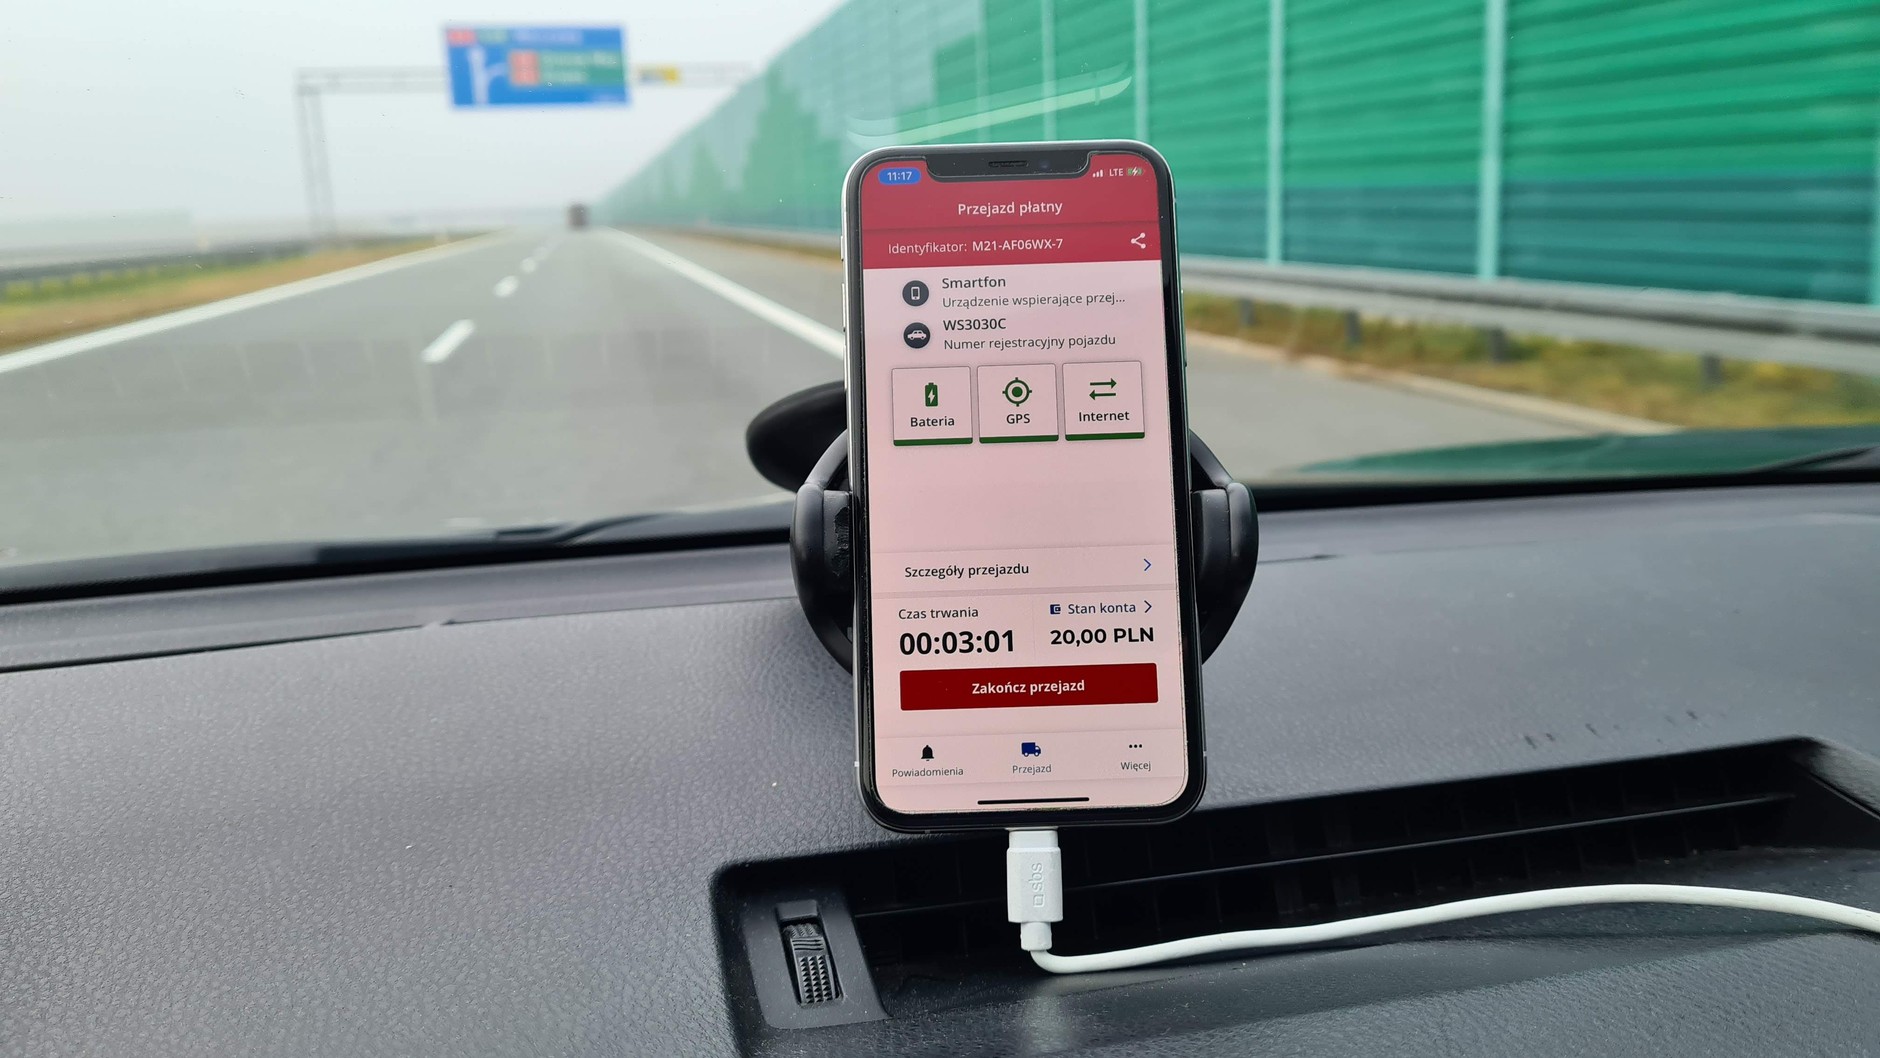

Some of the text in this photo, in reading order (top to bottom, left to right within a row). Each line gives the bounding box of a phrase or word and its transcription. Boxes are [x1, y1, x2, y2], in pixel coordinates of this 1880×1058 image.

[887, 170, 912, 182] 11:17
[1109, 168, 1124, 177] LTE
[957, 200, 1063, 218] Przejazd płatny
[888, 238, 1064, 257] Identyfikator: M21-AF06WX-7
[941, 276, 1006, 289] Smartfon
[942, 293, 1126, 310] Urządzenie wspierające przej...
[943, 318, 1006, 331] WS3030C
[944, 334, 1116, 352] Numer rejestracyjny pojazdu
[910, 415, 955, 428] Bateria
[1006, 413, 1031, 425] GPS
[1078, 410, 1130, 423] Internet
[904, 562, 1029, 580] Szczegóły przejazdu
[898, 606, 979, 620] Czas trwania
[1067, 601, 1136, 615] Stan konta
[899, 629, 1014, 656] 00:03:01
[1050, 627, 1154, 648] 20,00 PLN
[971, 680, 1085, 696] Zakończ przejazd
[892, 765, 964, 778] Powiadomienia
[1012, 763, 1052, 776] Przejazd
[1120, 760, 1152, 773] Więcej
[1028, 862, 1045, 893] sbs
